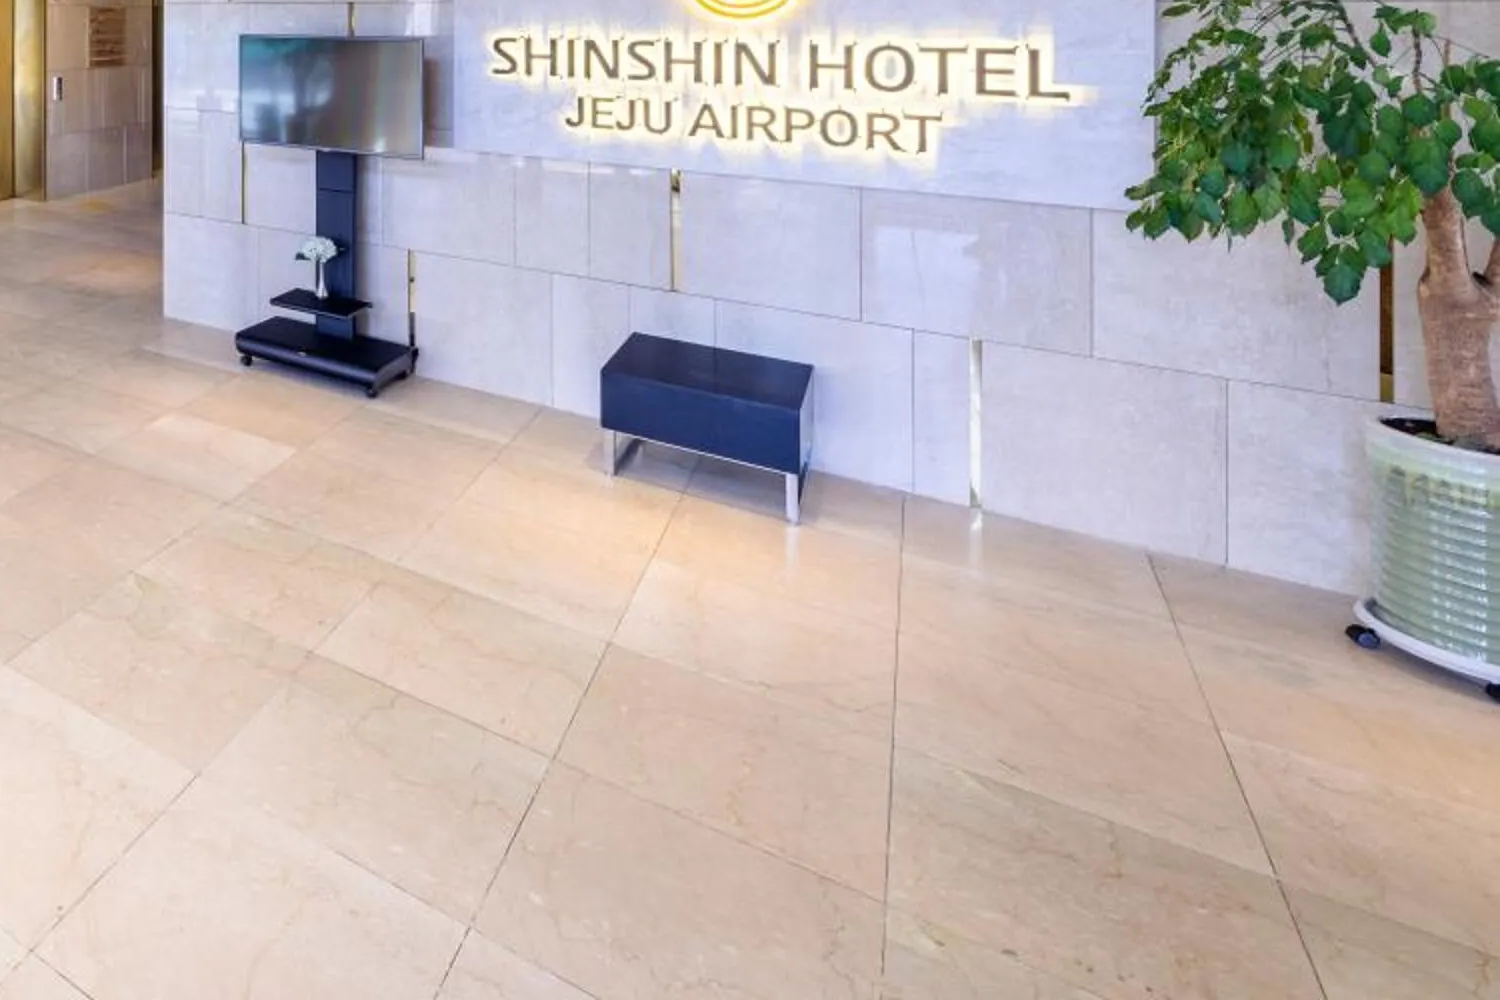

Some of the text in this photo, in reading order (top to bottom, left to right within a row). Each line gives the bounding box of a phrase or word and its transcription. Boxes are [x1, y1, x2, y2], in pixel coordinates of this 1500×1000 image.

[491, 34, 1071, 101] SHINSHIN HOTEL
[564, 96, 944, 154] JEJU AIRPORT
